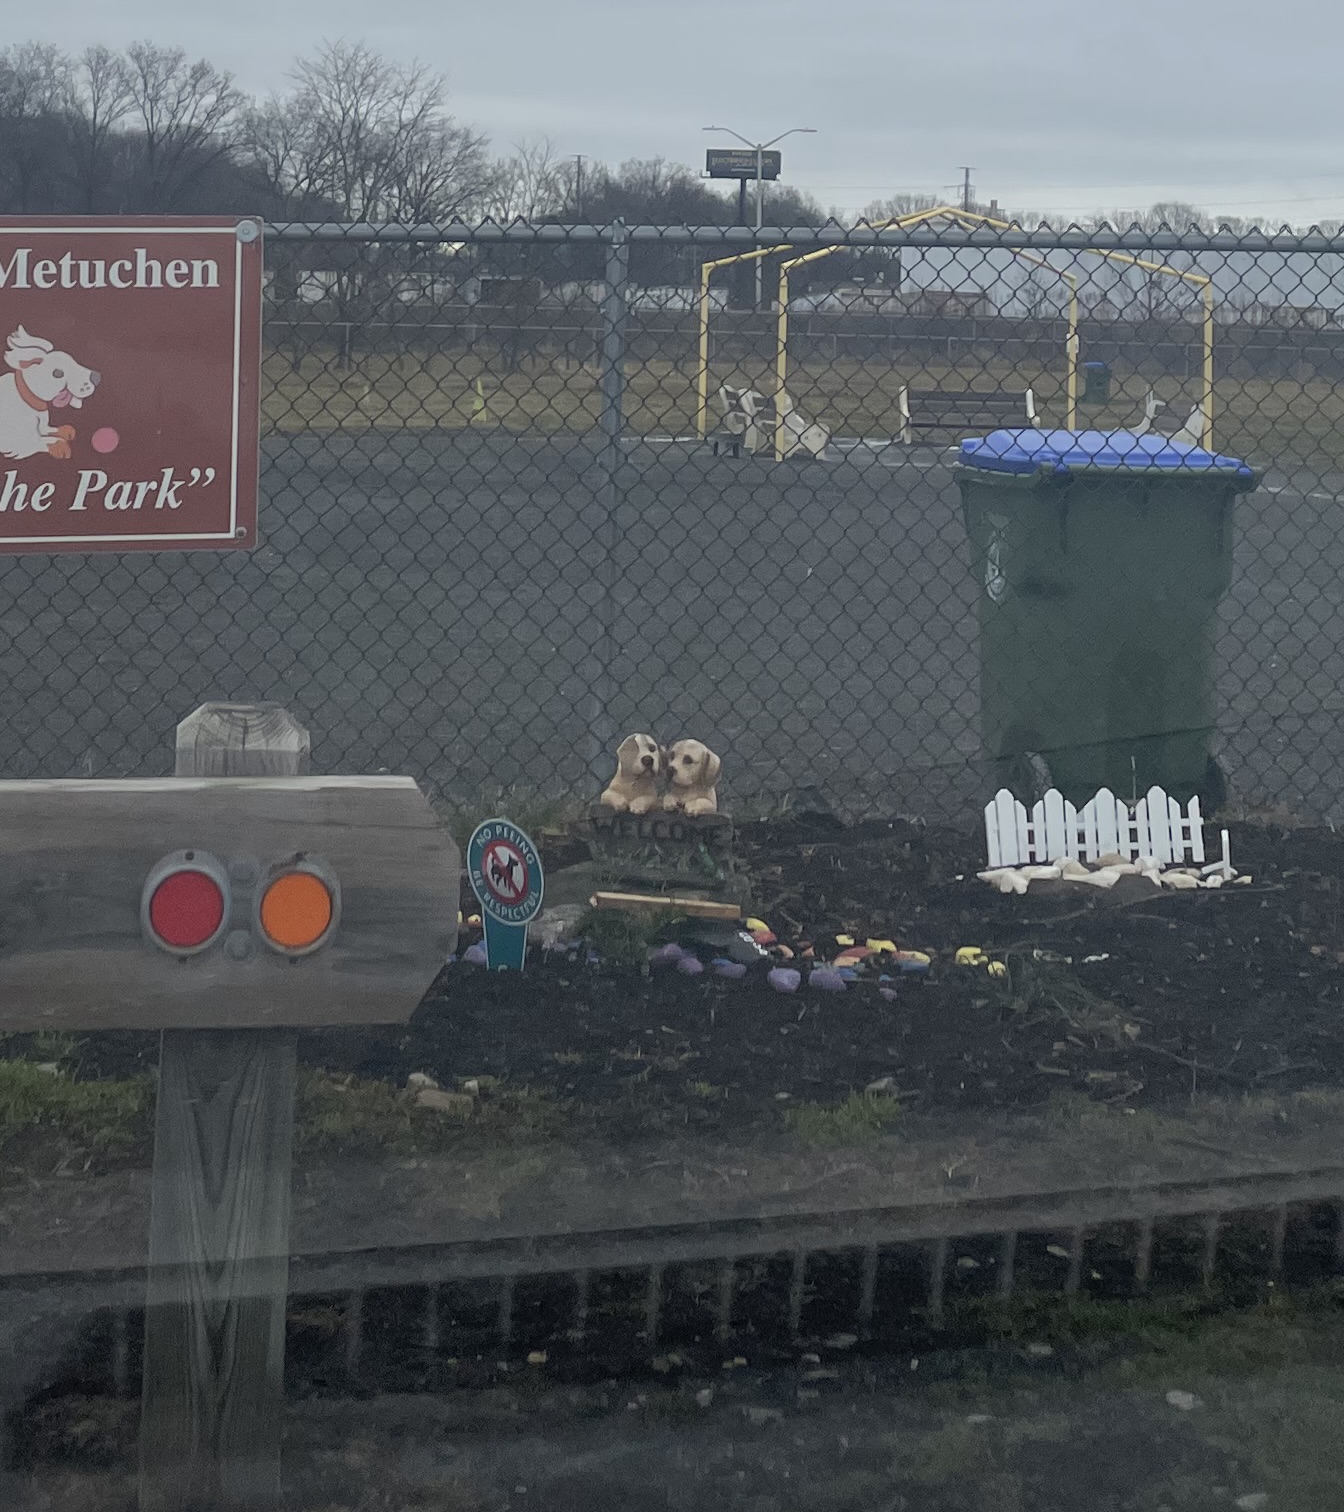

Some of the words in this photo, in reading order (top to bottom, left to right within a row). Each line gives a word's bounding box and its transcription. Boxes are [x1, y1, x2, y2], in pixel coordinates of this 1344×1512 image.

[68, 467, 216, 512] Park”
[476, 828, 492, 848] NO
[496, 825, 535, 864] PEEING
[473, 870, 484, 887] BE
[484, 891, 539, 919] RESPECTFUL
